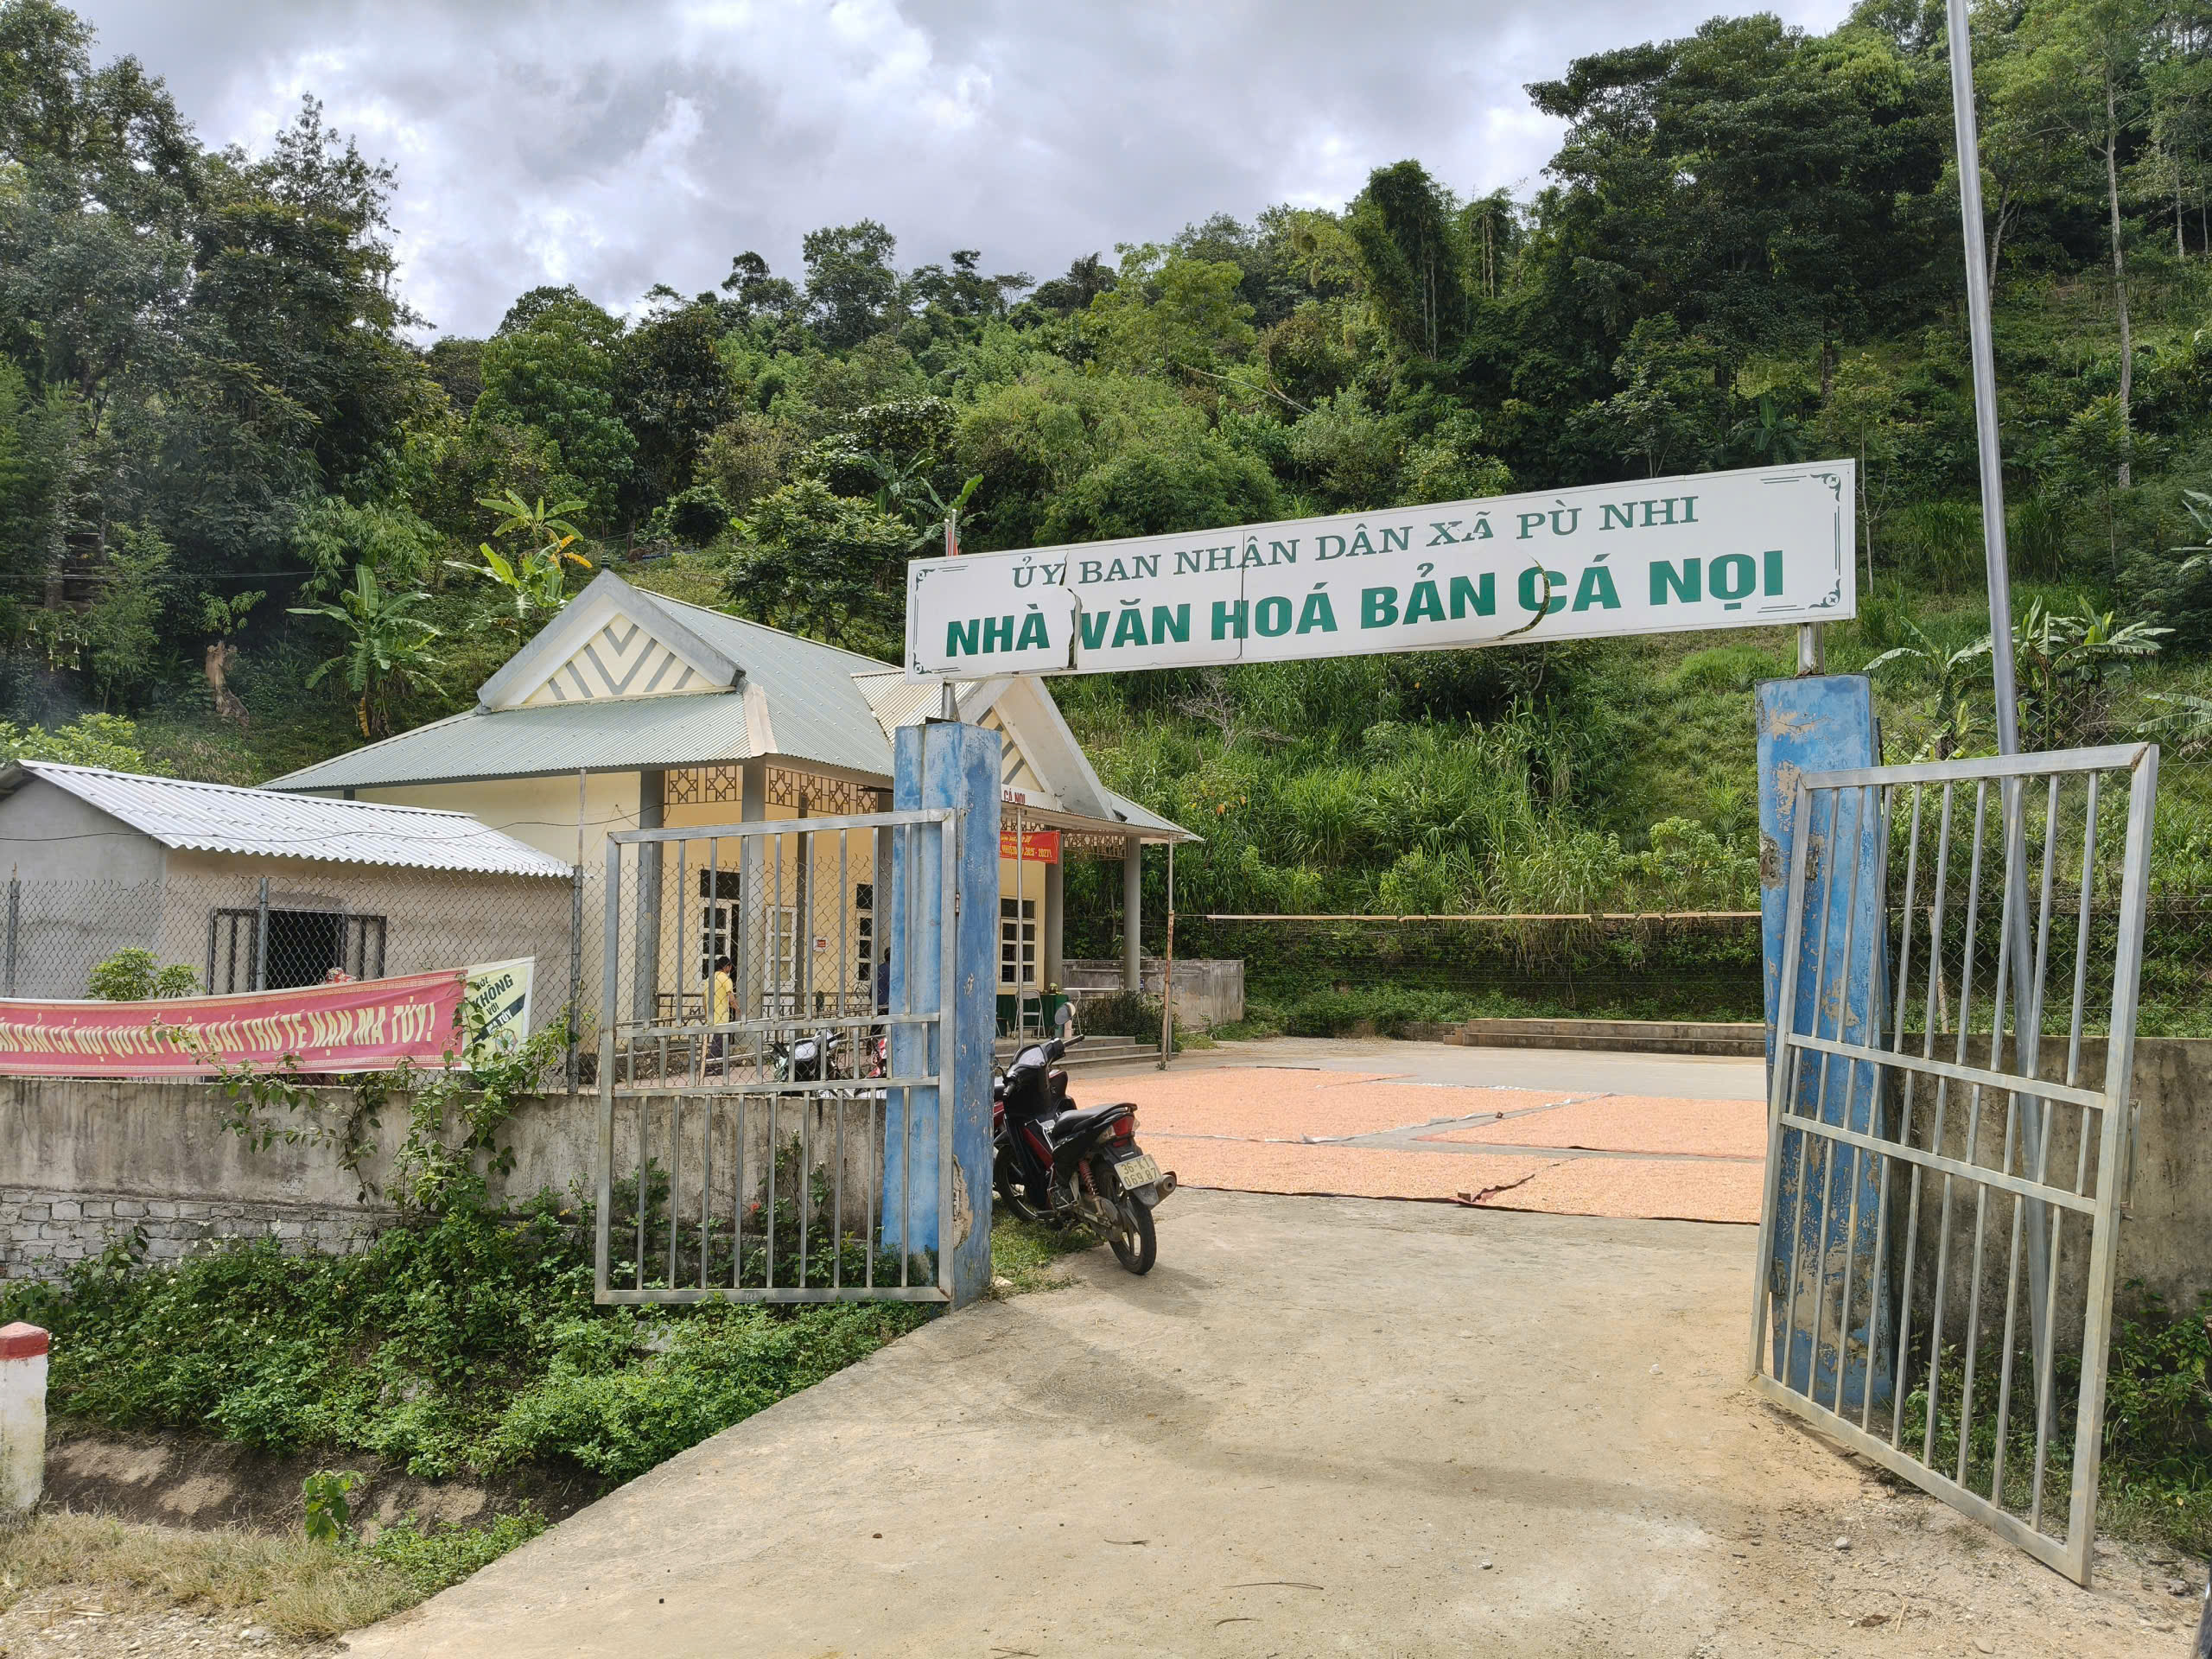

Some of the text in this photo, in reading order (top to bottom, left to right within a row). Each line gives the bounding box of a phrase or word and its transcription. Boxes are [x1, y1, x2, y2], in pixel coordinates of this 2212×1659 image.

[1012, 495, 1700, 588] ỦY BAN NHÂN DÂN XÃ PÙ NHI
[945, 550, 1784, 658] NHÀ VĂN HOÁ BẢN CÁ NỌI
[472, 974, 514, 1010] KHÔNG
[307, 1010, 353, 1056] NẠN
[353, 1006, 386, 1046] MA
[391, 995, 435, 1044] TÚY!
[1121, 1157, 1150, 1174] 36-K1
[1123, 1167, 1158, 1187] 069.87
